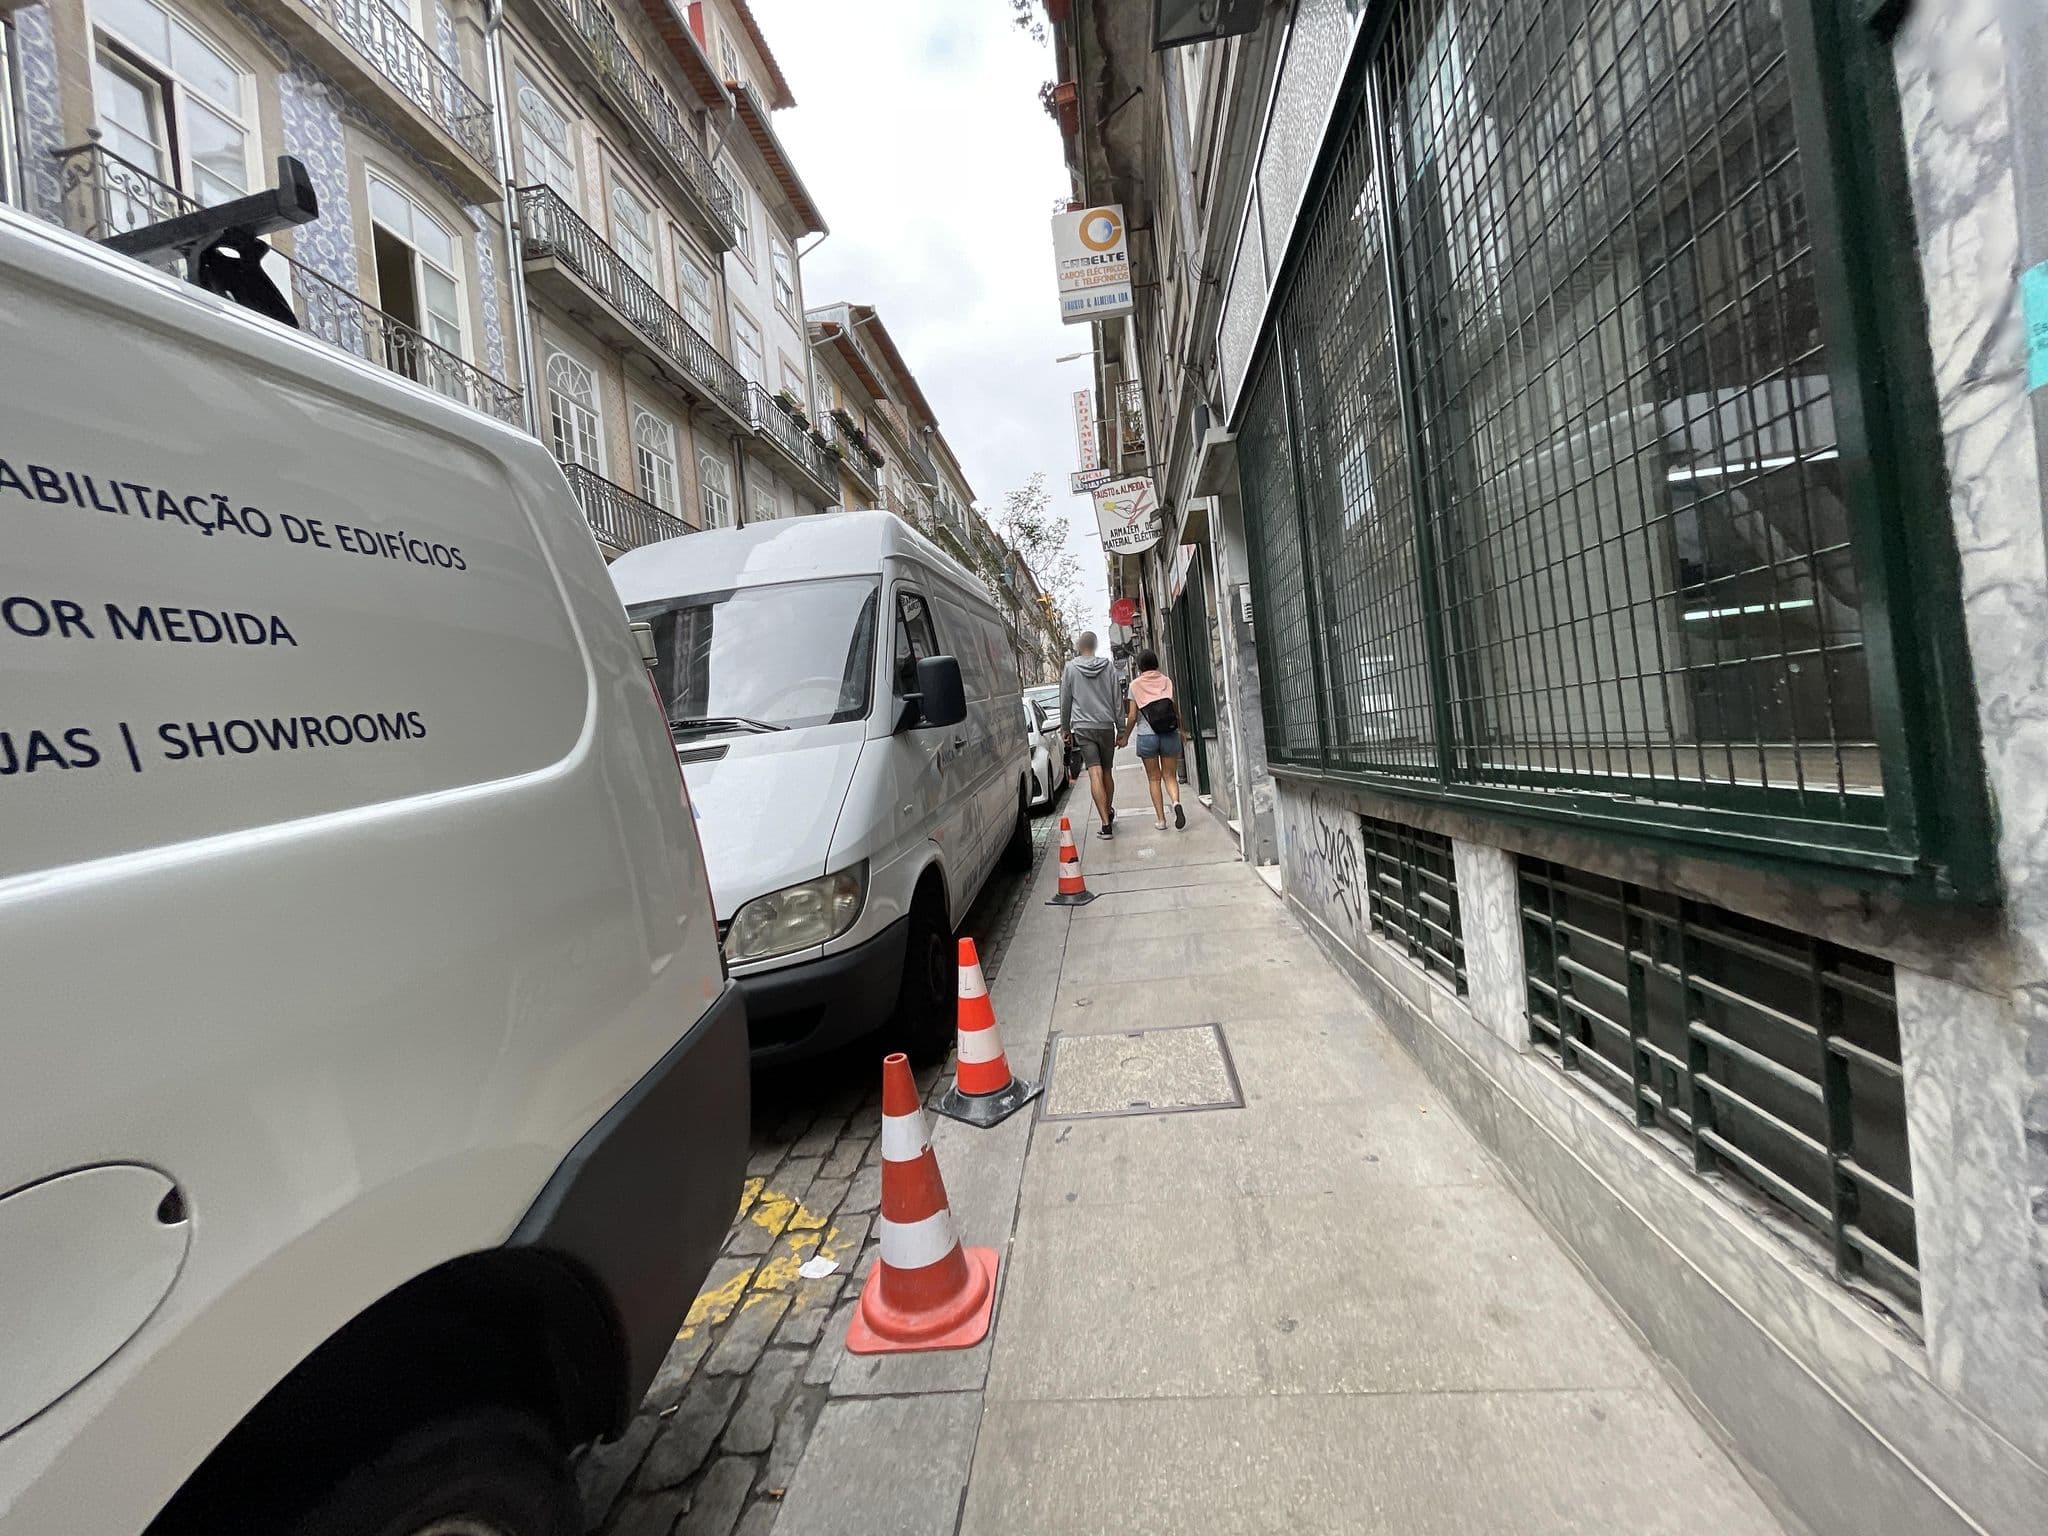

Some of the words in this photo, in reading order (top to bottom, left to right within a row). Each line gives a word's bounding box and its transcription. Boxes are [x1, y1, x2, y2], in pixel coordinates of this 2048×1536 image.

[1060, 269, 1085, 281] CABOS
[1075, 279, 1080, 287] E
[1094, 294, 1116, 306] ALMEIDA
[1078, 390, 1095, 470] ALOJAMENTO
[1094, 487, 1116, 499] FAUSTO
[1121, 481, 1145, 494] ALMEIDA
[1145, 522, 1154, 531] DE
[280, 513, 332, 548] DE
[335, 531, 467, 571] EDIFÍCIOS
[1103, 537, 1133, 550] MATERIAL
[0, 597, 95, 639] OR
[104, 603, 298, 646] MEDIDA
[157, 711, 427, 760] SHOWROOMS
